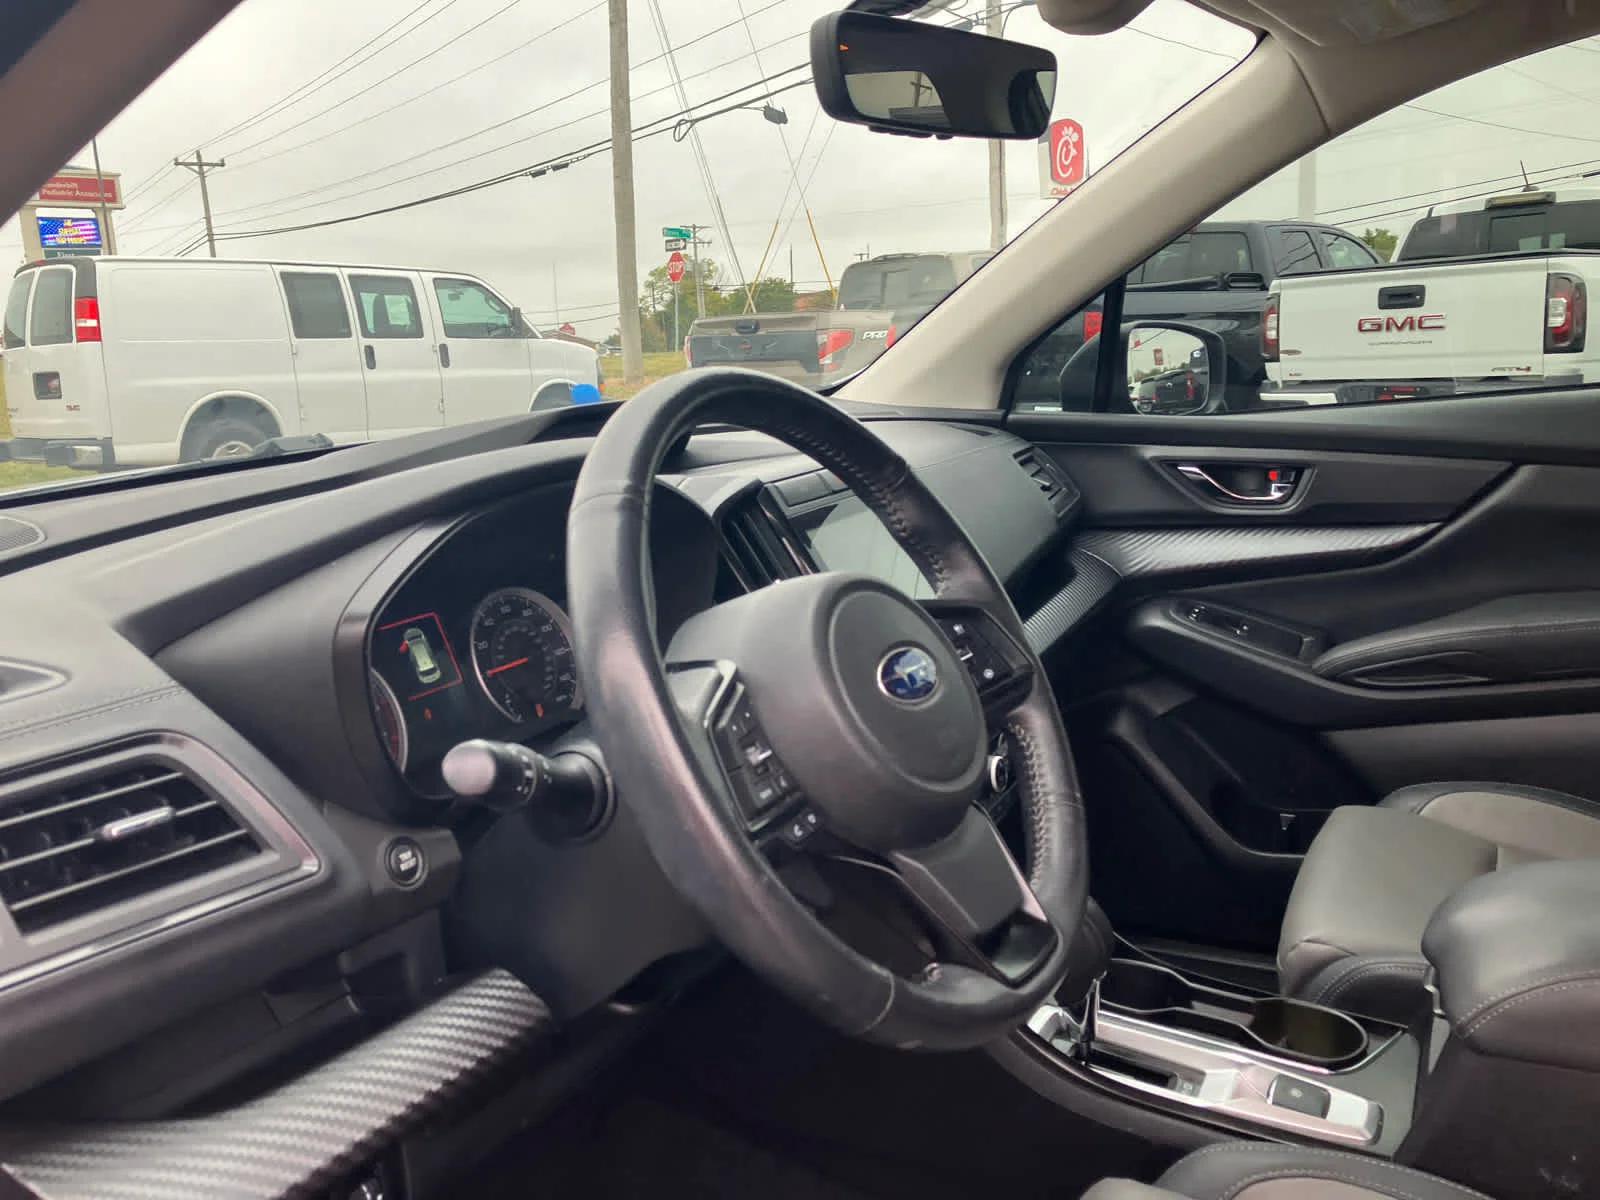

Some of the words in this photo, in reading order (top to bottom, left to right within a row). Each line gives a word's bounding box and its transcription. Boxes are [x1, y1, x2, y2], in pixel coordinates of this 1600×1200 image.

[75, 190, 113, 198] Associaes
[668, 261, 684, 273] STOP
[1357, 314, 1446, 333] GMC
[862, 330, 889, 340] PRO
